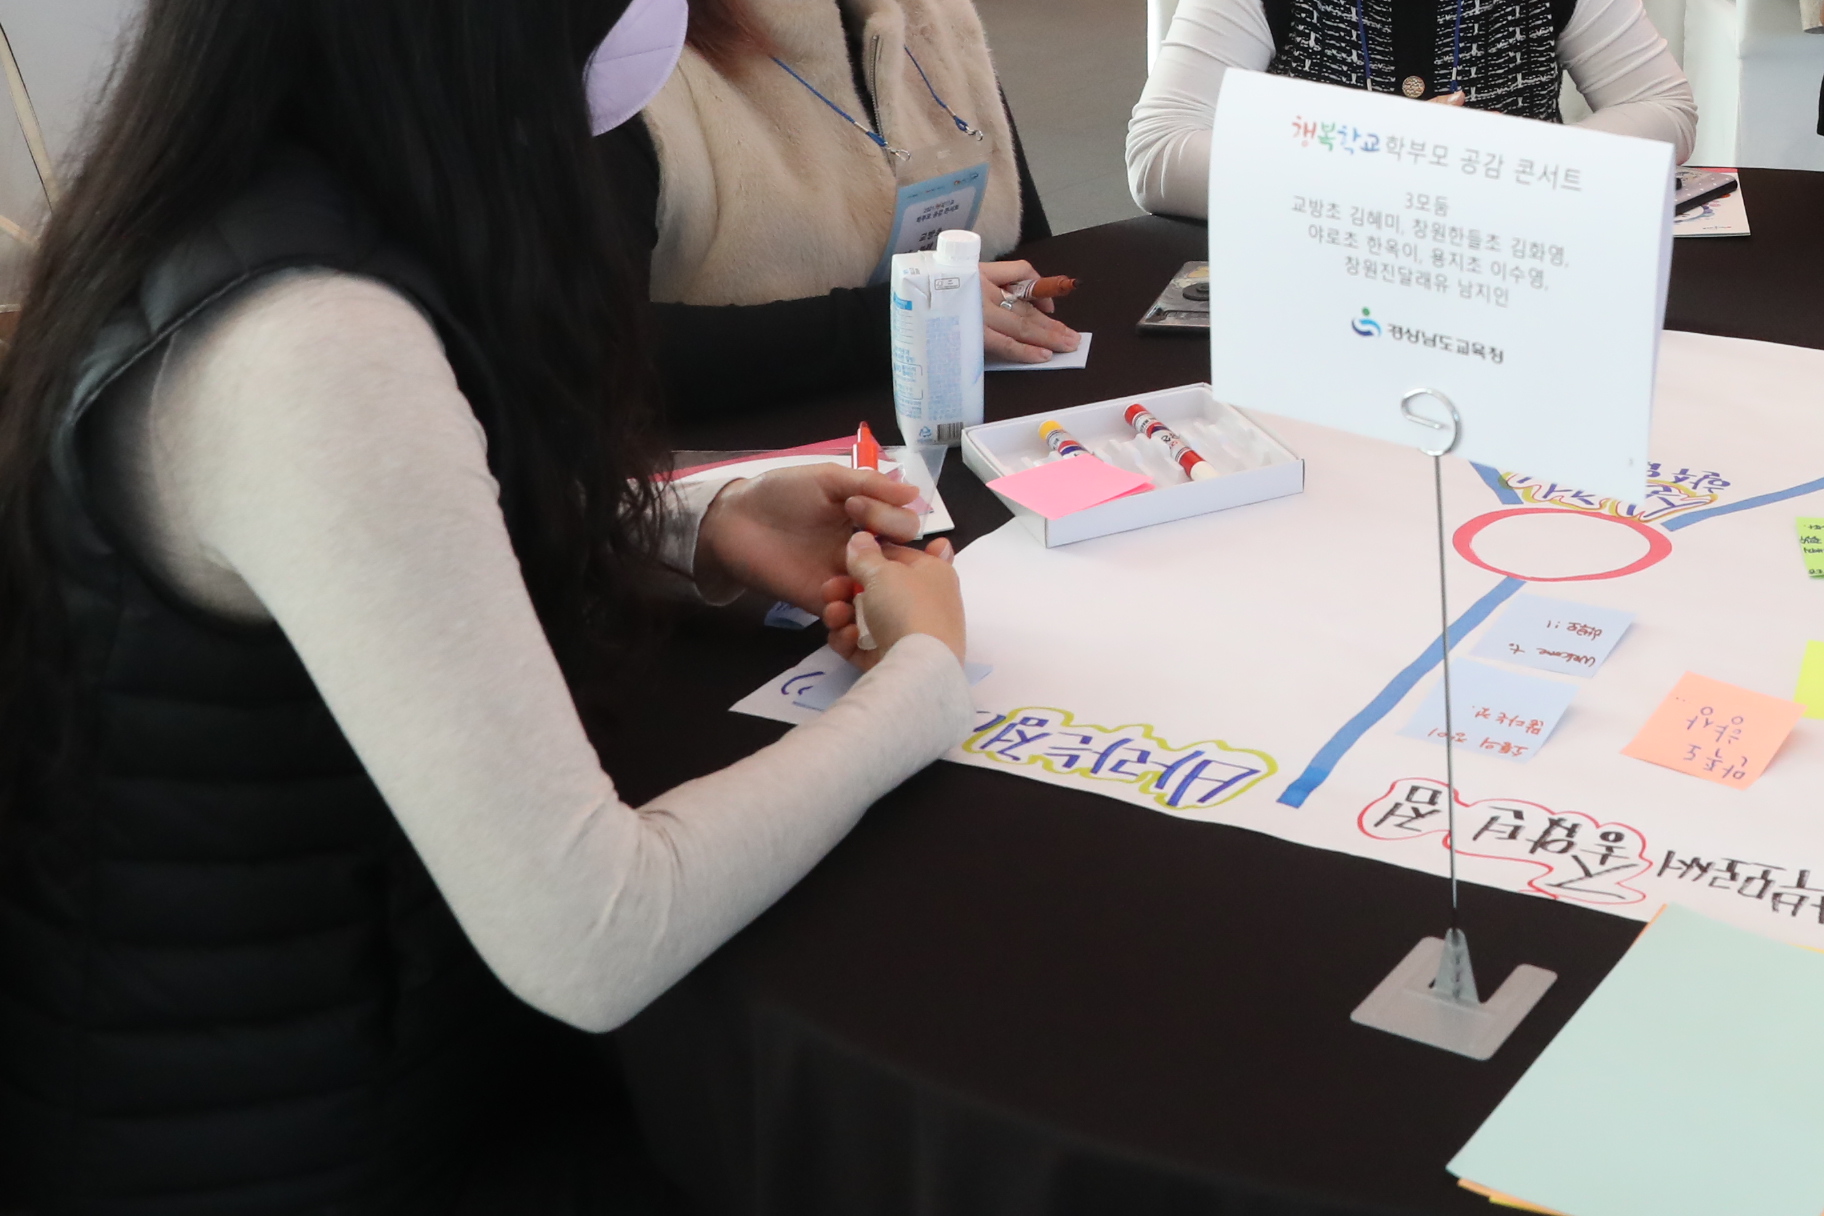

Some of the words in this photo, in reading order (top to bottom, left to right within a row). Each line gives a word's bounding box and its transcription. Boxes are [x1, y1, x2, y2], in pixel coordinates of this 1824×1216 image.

[1459, 147, 1505, 179] 공감
[1514, 157, 1582, 192] 콘서트
[1291, 195, 1342, 221] 교방초
[1405, 192, 1449, 217] 3모둠
[1308, 224, 1359, 249] 야로초
[1430, 247, 1482, 275] 용지초
[1387, 323, 1505, 365] 경상남도교육청
[1683, 743, 1748, 780] 만족도
[1372, 785, 1442, 833] 점
